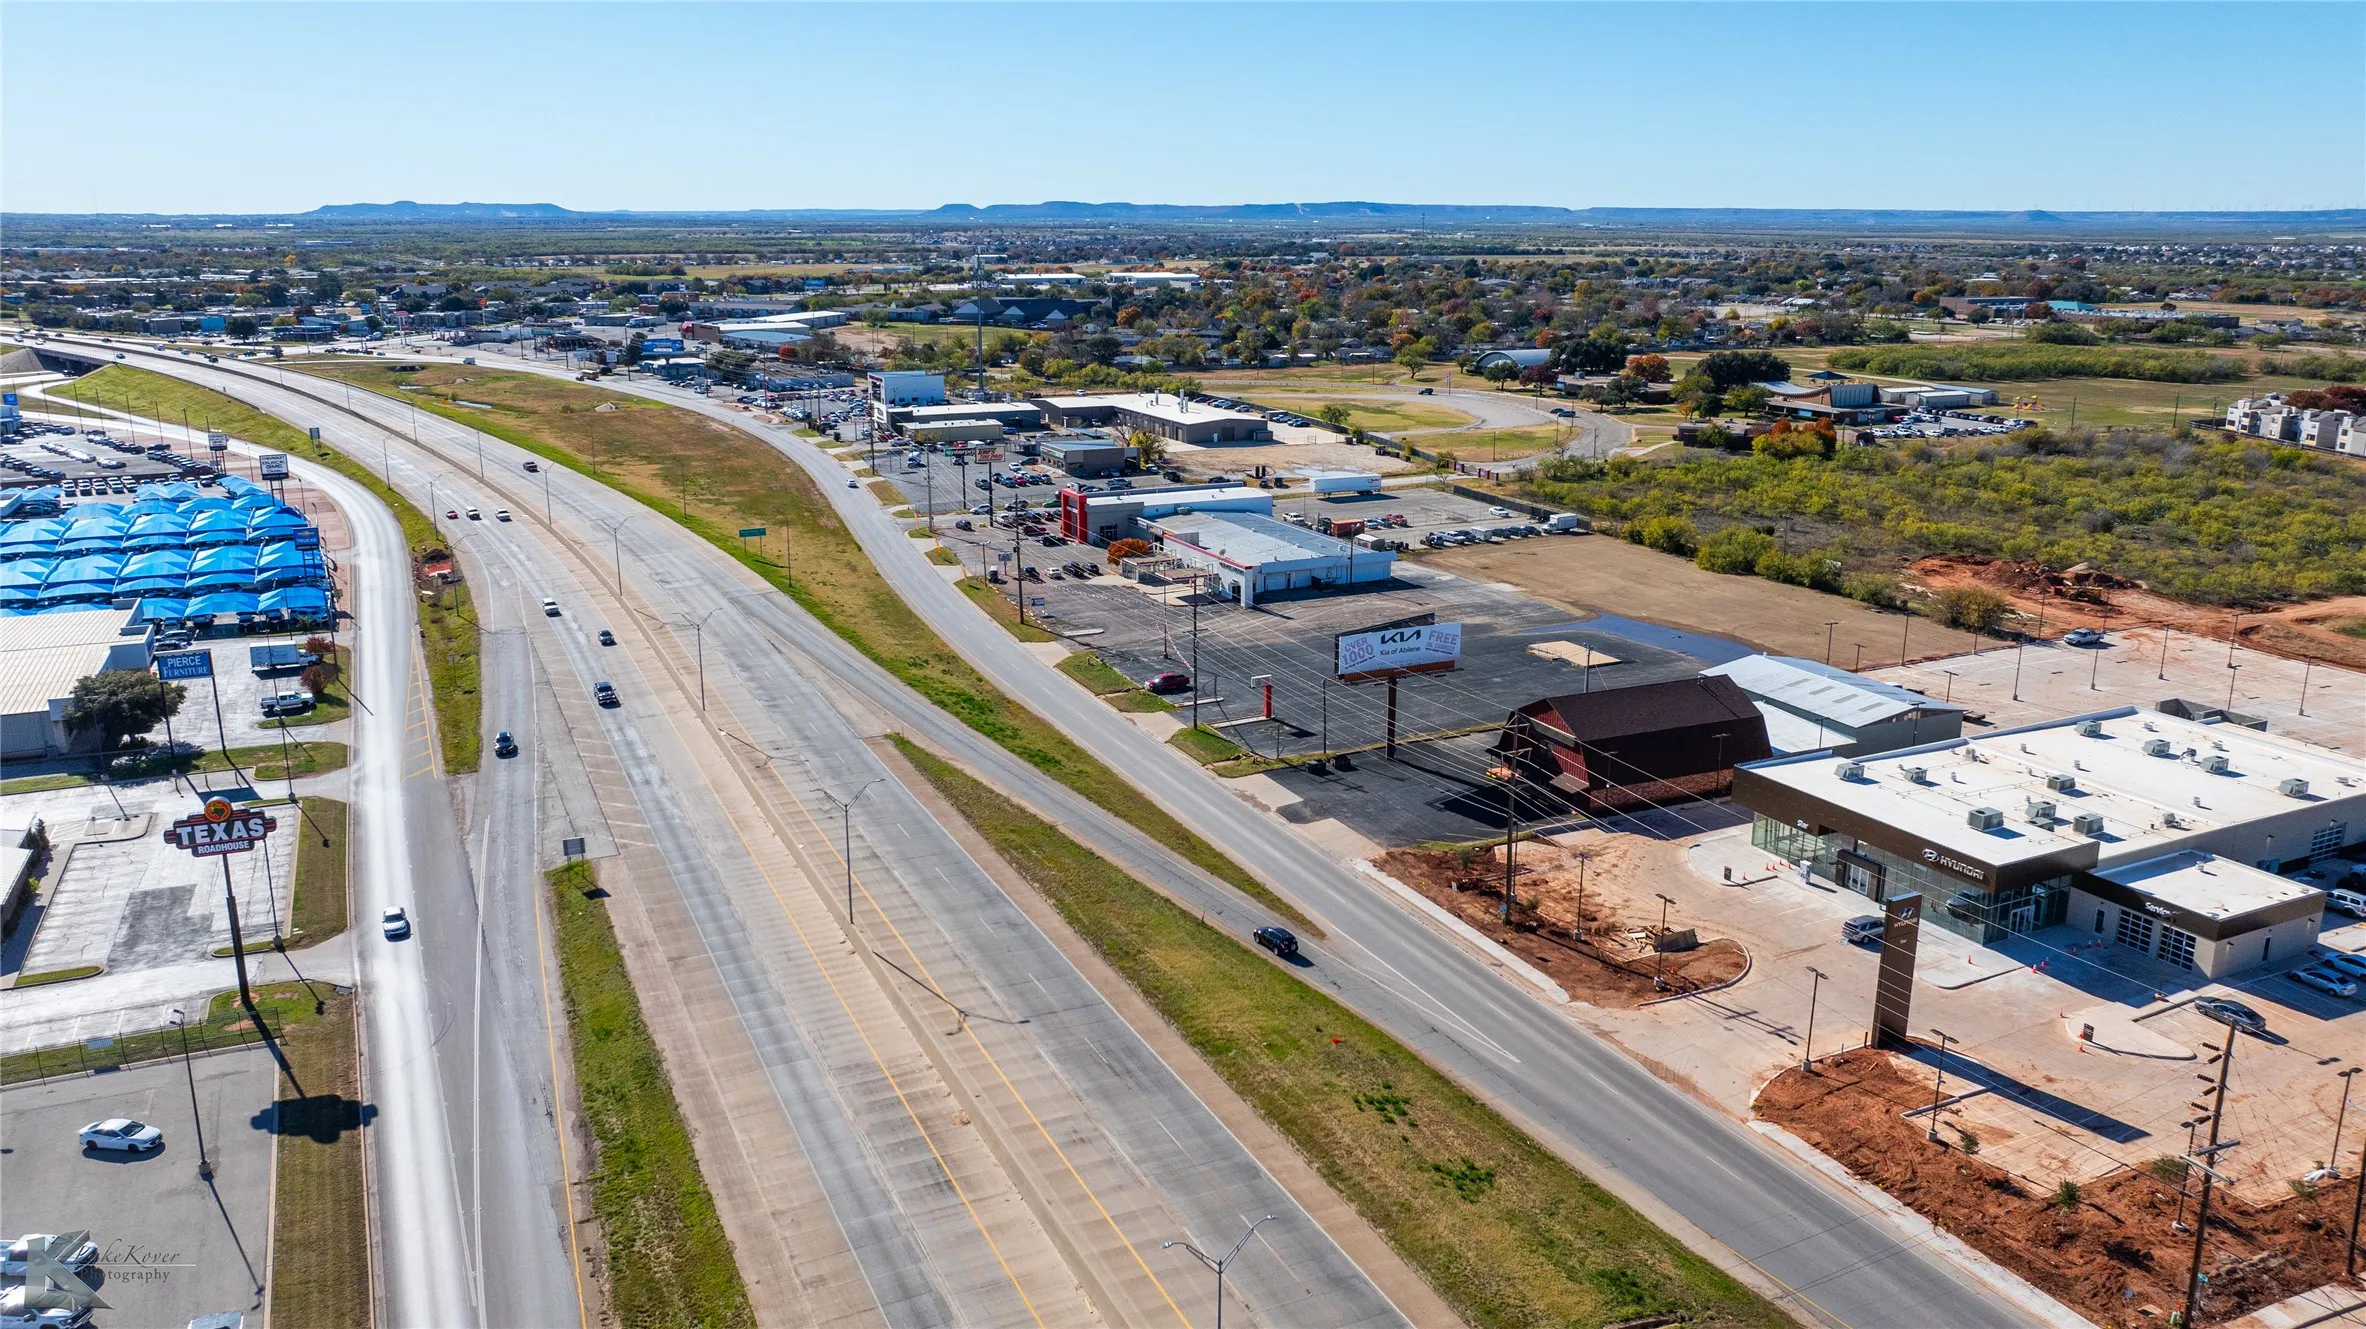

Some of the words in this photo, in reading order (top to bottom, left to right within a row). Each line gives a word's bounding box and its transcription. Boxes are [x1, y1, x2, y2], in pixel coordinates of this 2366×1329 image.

[1344, 637, 1369, 653] OVER
[1428, 629, 1459, 646] FREE
[167, 655, 201, 667] PIERCE
[162, 665, 209, 678] FURNITURE
[176, 818, 265, 845] TEXAS
[198, 840, 250, 854] ROADHOUSE
[1940, 855, 1985, 880] HYUNDAI
